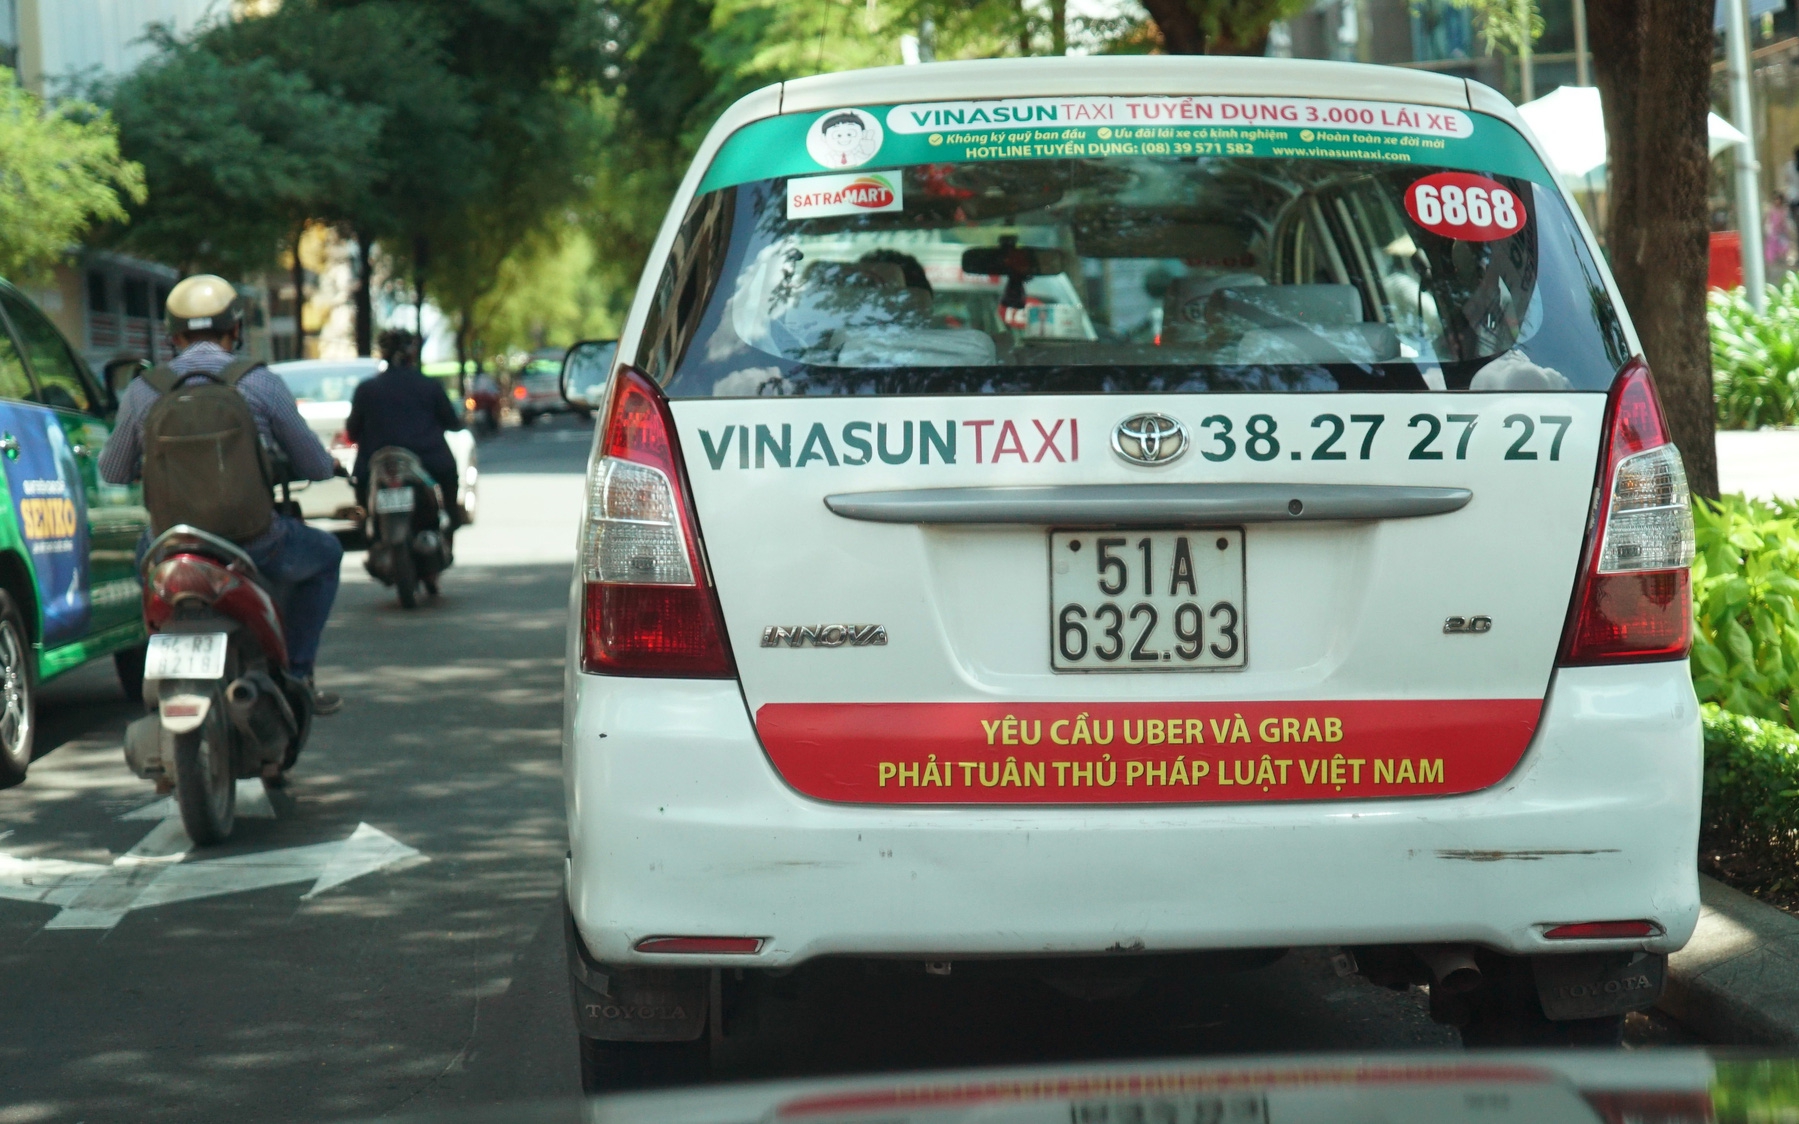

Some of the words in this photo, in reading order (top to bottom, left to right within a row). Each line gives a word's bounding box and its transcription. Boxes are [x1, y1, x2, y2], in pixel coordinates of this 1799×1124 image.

[1126, 98, 1213, 120] TUYỂN
[1221, 103, 1298, 125] DỤNG
[1305, 106, 1374, 124] 3.000
[1381, 108, 1420, 128] LÁI
[1426, 112, 1458, 132] XE
[946, 132, 988, 145] Không
[990, 131, 1005, 143] ký
[1008, 130, 1032, 143] quỹ
[1034, 130, 1059, 141] ban
[1061, 128, 1086, 140] đầu
[1114, 128, 1133, 139] Ưu
[1135, 128, 1157, 139] đãi
[1157, 128, 1175, 139] lái
[1176, 130, 1191, 139] xe
[1192, 128, 1209, 139] có
[1209, 128, 1238, 140] kinh
[1239, 128, 1288, 143] nghiệm
[1316, 131, 1350, 143] Hoàn
[1352, 132, 1381, 144] toàn
[1383, 136, 1398, 145] xe
[1400, 135, 1420, 148] đời
[1421, 138, 1445, 149] mới
[966, 144, 1032, 159] HOTLINE
[1034, 140, 1085, 156] TUYỂN
[1088, 143, 1138, 157] DỤNG:
[1141, 142, 1170, 155] (08)
[1174, 143, 1194, 154] 39
[1195, 143, 1221, 154] 571
[1226, 143, 1254, 155] 582
[1272, 146, 1411, 162] www.vinasuntaxi.com
[793, 187, 889, 208] SATRAMART
[1414, 184, 1518, 229] 6868
[1407, 413, 1479, 461] 27
[1502, 414, 1573, 461] 27
[1097, 537, 1197, 596] 51A
[760, 624, 888, 648] INNOVA
[1059, 602, 1239, 661] 632.93
[1443, 615, 1492, 634] 2.0
[981, 714, 1042, 745] YÊU
[1050, 711, 1114, 745] CẦU
[1123, 718, 1204, 744] UBER
[1210, 713, 1251, 743] VÀ
[1259, 717, 1343, 743] GRAB
[879, 754, 952, 787] PHẢI
[959, 756, 1045, 787] TUÂN
[1052, 753, 1116, 787] THỦ
[1126, 755, 1209, 786] PHÁP
[1218, 754, 1293, 792] LUẬT
[1299, 753, 1366, 792] VIỆT
[1374, 758, 1444, 784] NAM
[1555, 974, 1652, 999] TOYOTA
[585, 1004, 687, 1019] TOYOTA
